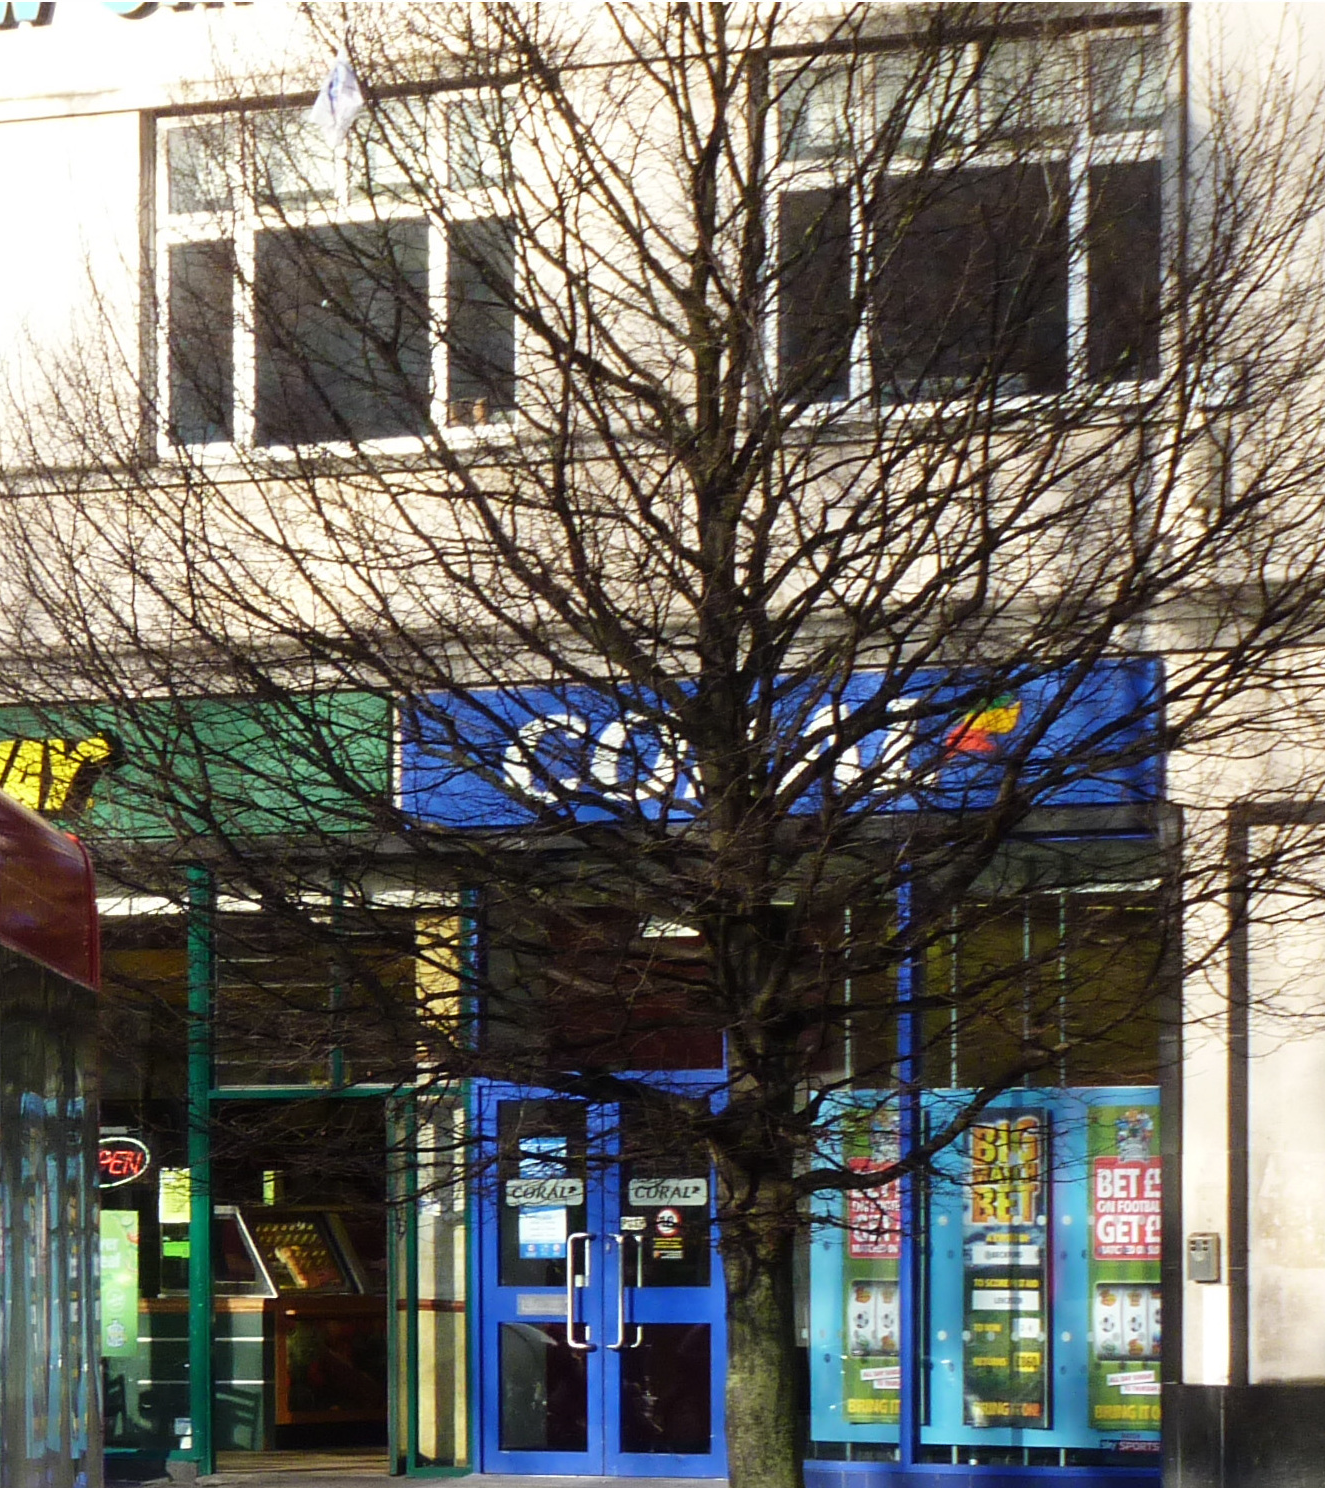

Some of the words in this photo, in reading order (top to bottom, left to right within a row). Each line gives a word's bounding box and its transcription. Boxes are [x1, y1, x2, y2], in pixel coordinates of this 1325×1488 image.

[502, 697, 942, 804] COAL
[971, 1116, 1039, 1165] BIG
[511, 1185, 568, 1200] CORAL
[633, 1185, 691, 1200] CORAL
[1096, 1168, 1141, 1199] BET
[971, 1183, 1040, 1224] BET
[1096, 1214, 1142, 1243] GET
